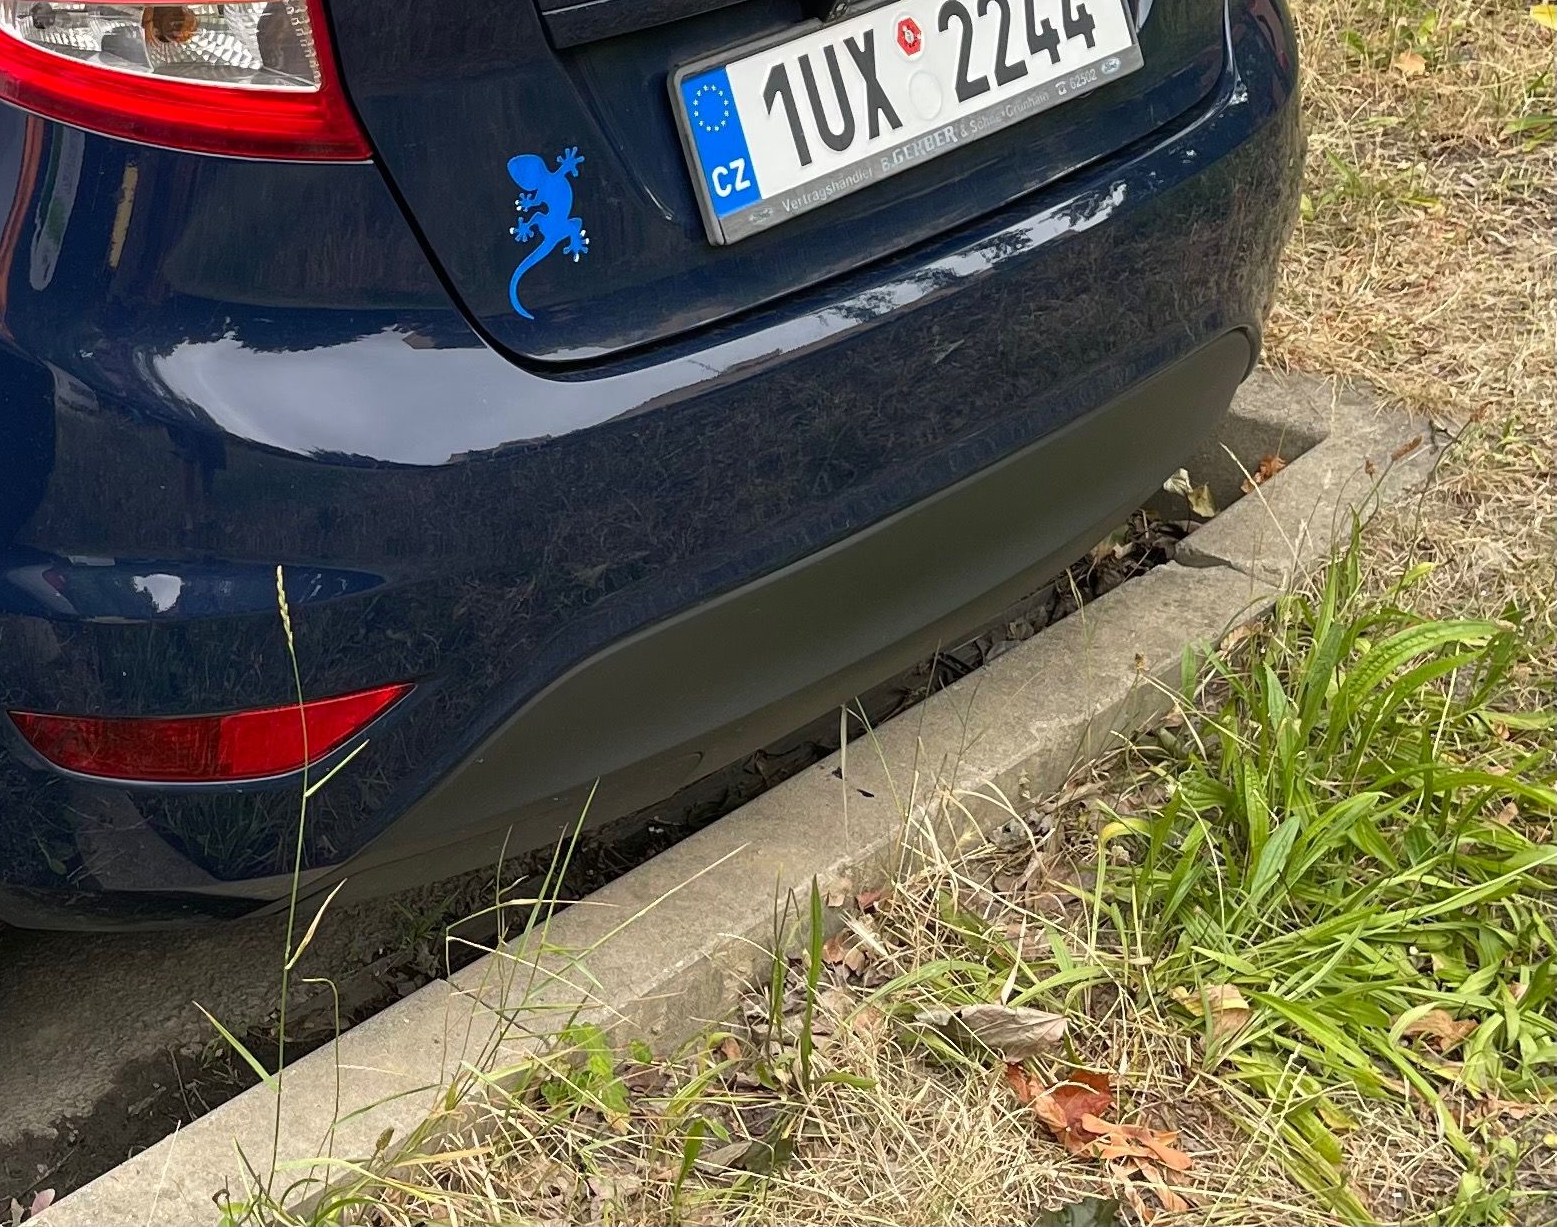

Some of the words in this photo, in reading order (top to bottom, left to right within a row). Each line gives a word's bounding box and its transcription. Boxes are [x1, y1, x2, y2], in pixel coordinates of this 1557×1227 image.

[762, 28, 903, 168] 1UX
[1069, 68, 1098, 90] 62502
[711, 157, 751, 198] CZ
